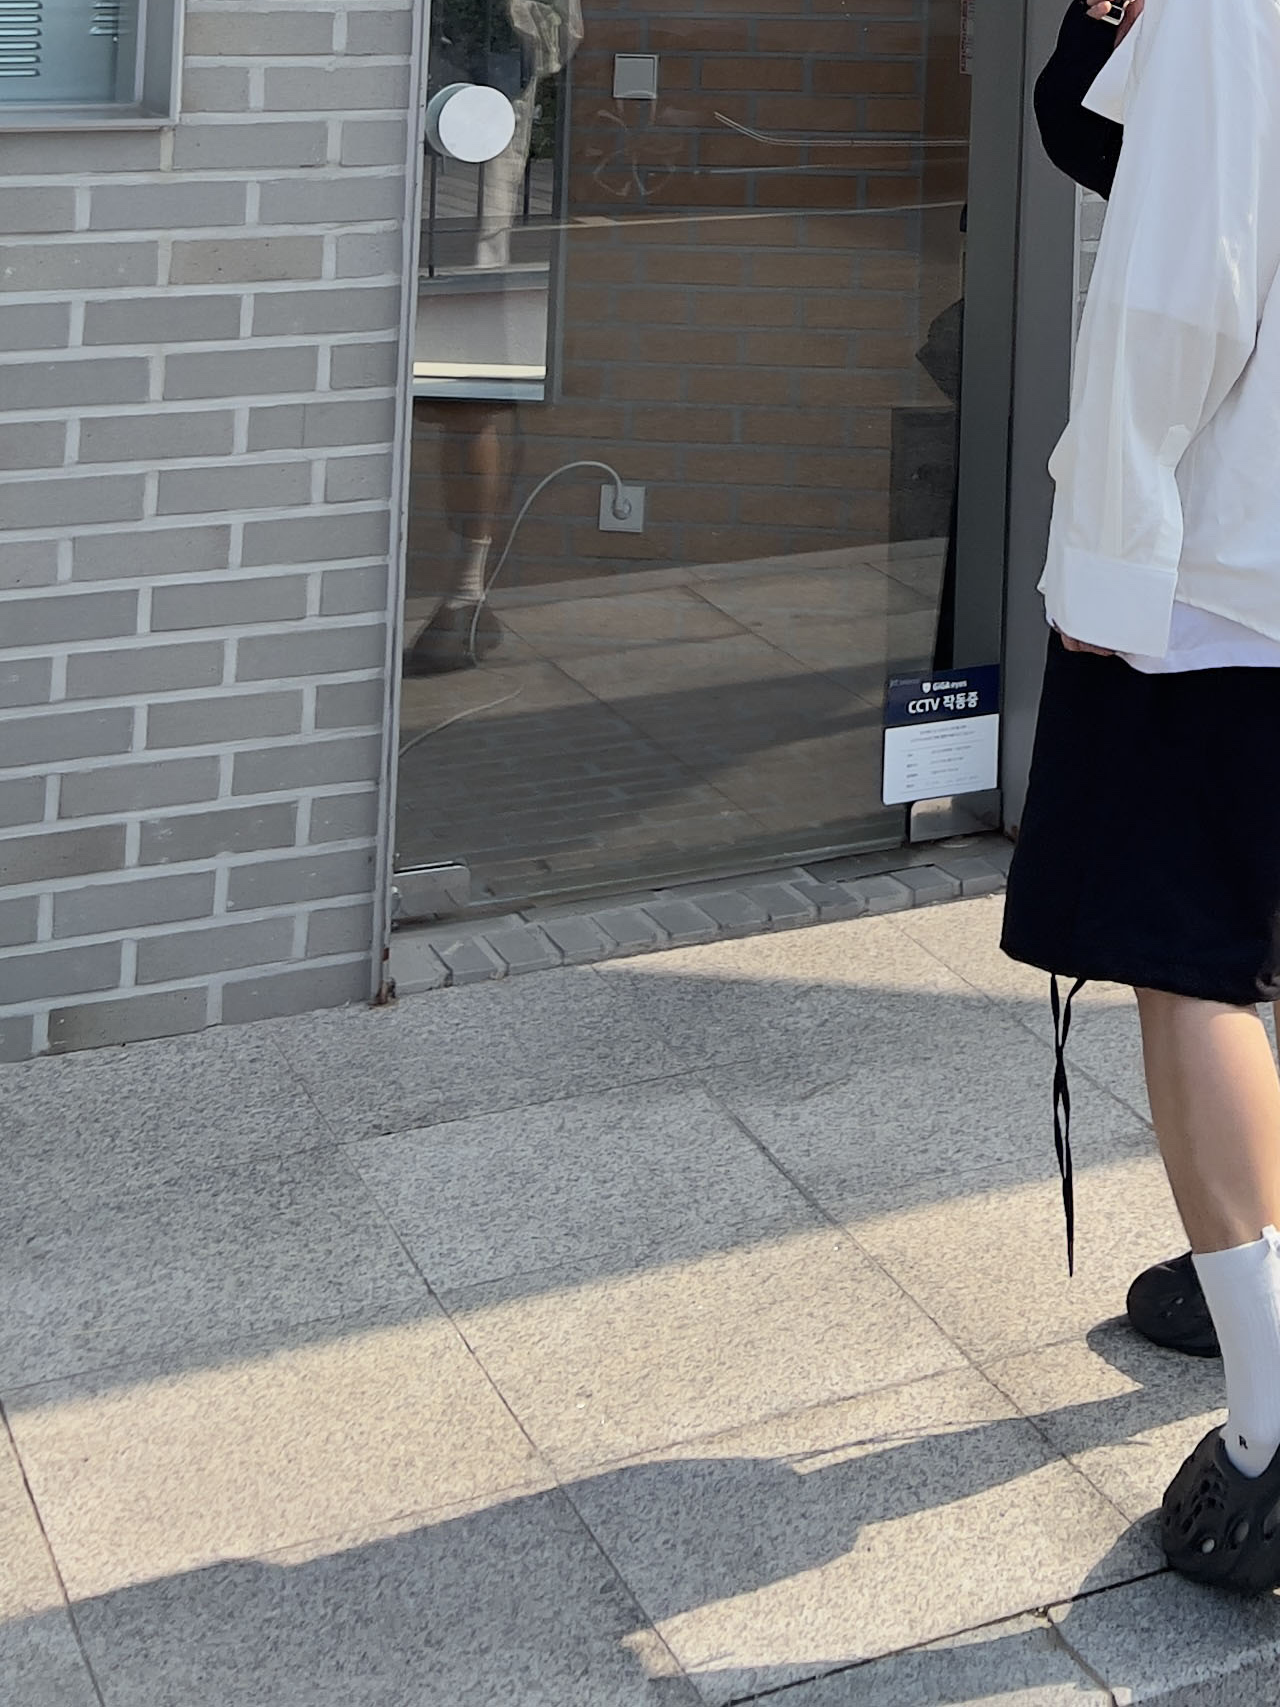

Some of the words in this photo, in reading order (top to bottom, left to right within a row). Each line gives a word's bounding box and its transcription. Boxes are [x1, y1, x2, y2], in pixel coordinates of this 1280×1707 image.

[908, 698, 940, 714] CCTV
[943, 692, 979, 711] 작동중
[1238, 1435, 1249, 1450] R
